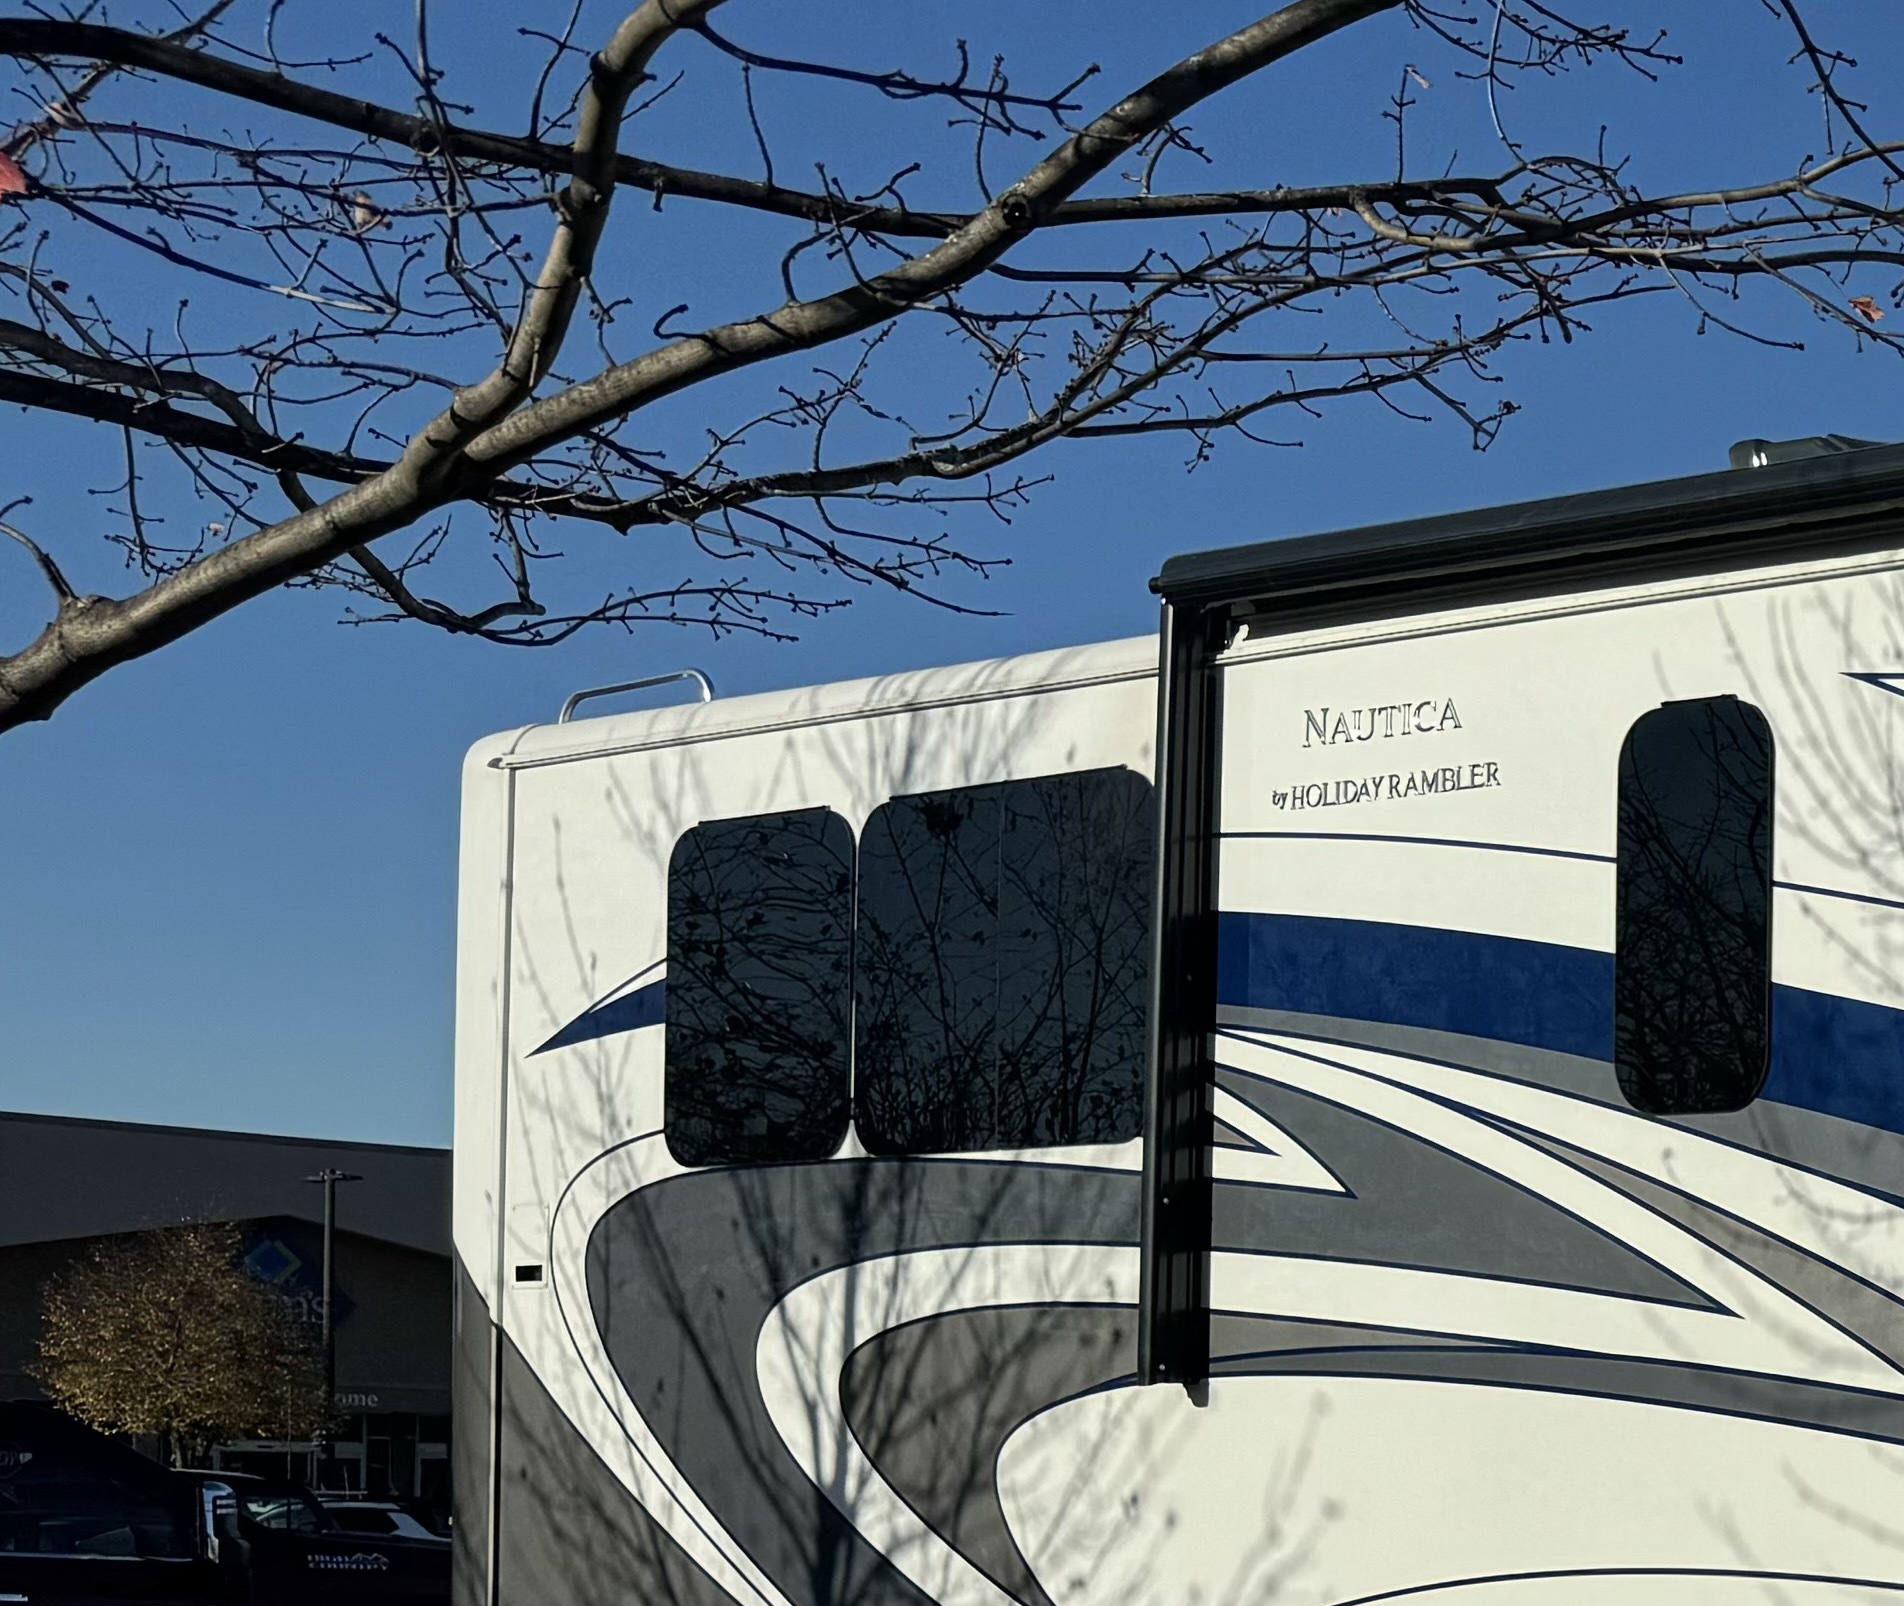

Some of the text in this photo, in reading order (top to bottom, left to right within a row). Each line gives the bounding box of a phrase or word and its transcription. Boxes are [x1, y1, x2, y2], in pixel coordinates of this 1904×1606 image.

[1302, 697, 1463, 748] NAUTICA
[1272, 761, 1502, 811] by HOLIDAY RAMBLER
